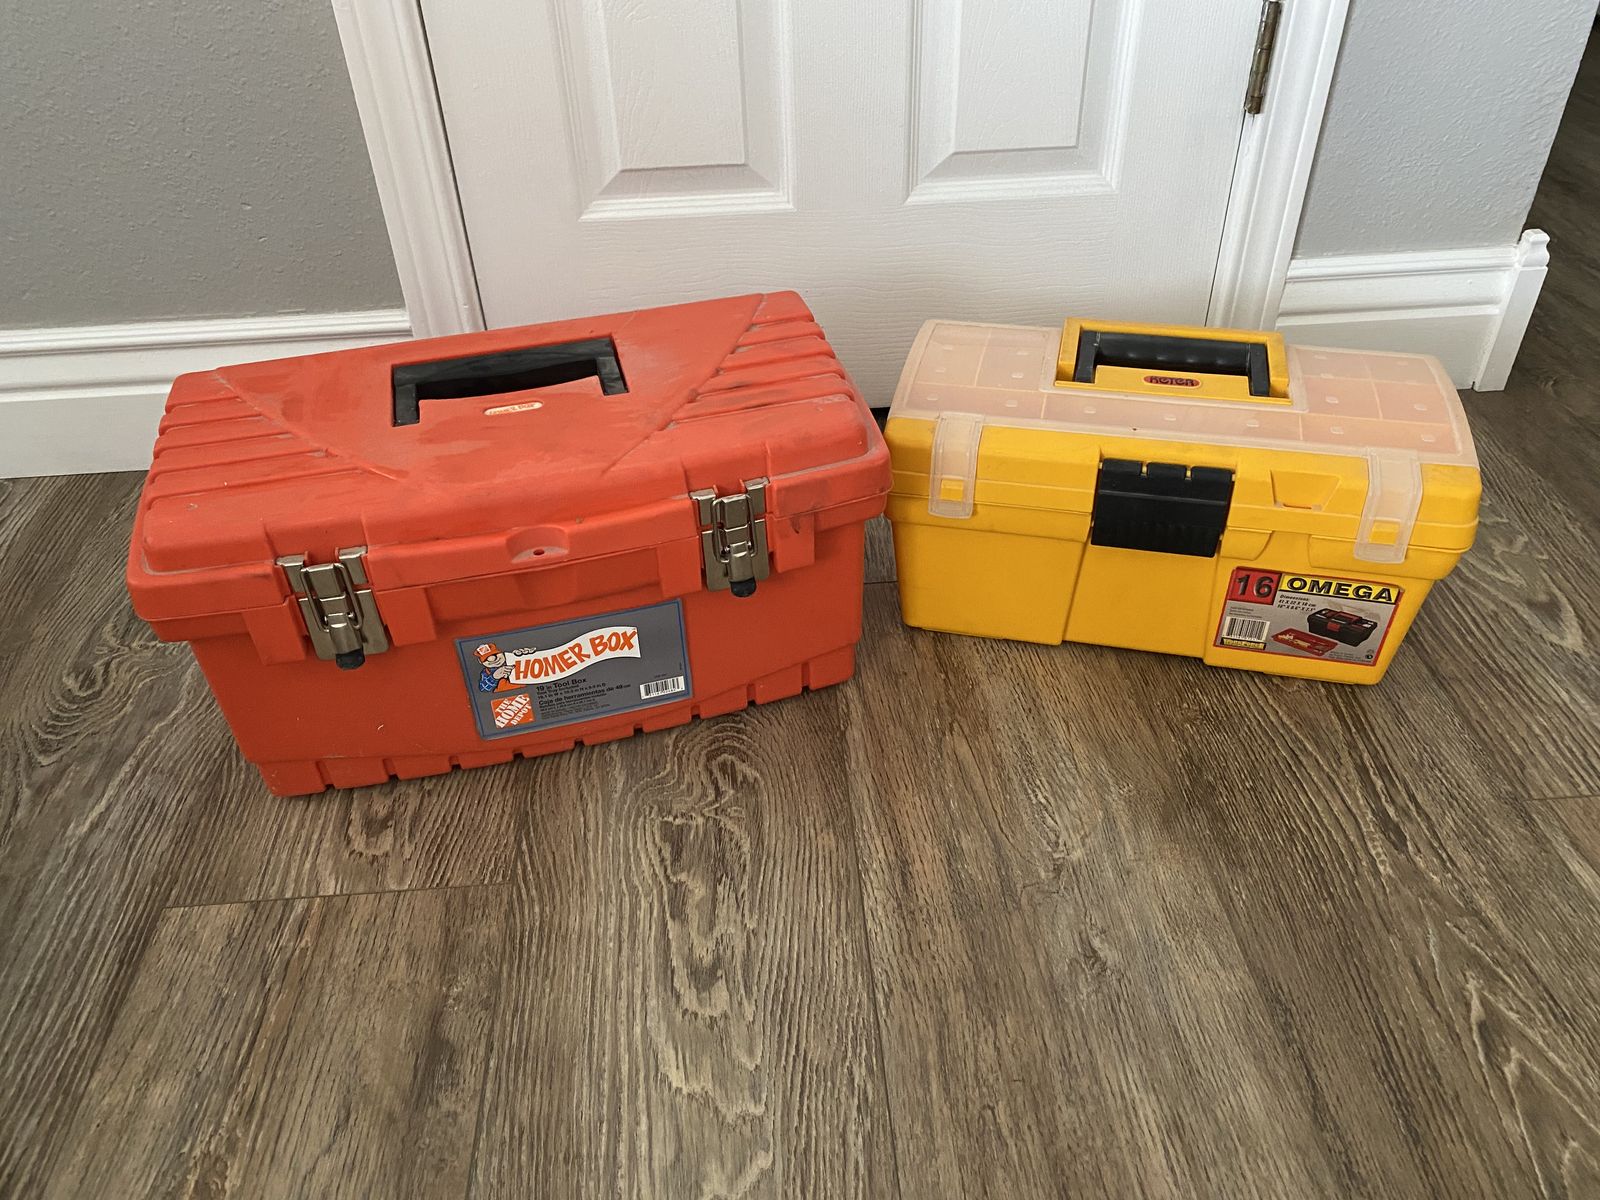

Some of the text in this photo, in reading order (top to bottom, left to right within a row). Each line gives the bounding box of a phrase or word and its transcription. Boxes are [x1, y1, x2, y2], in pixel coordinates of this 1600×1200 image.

[1235, 573, 1274, 599] 16
[1286, 576, 1393, 603] OMEGA
[514, 630, 638, 681] HOMER BOX
[553, 681, 570, 689] Tool
[495, 698, 511, 713] THE
[538, 699, 553, 707] Caja
[563, 689, 606, 701] herramientas
[495, 694, 530, 728] HOME
[510, 703, 532, 725] DEPOT
